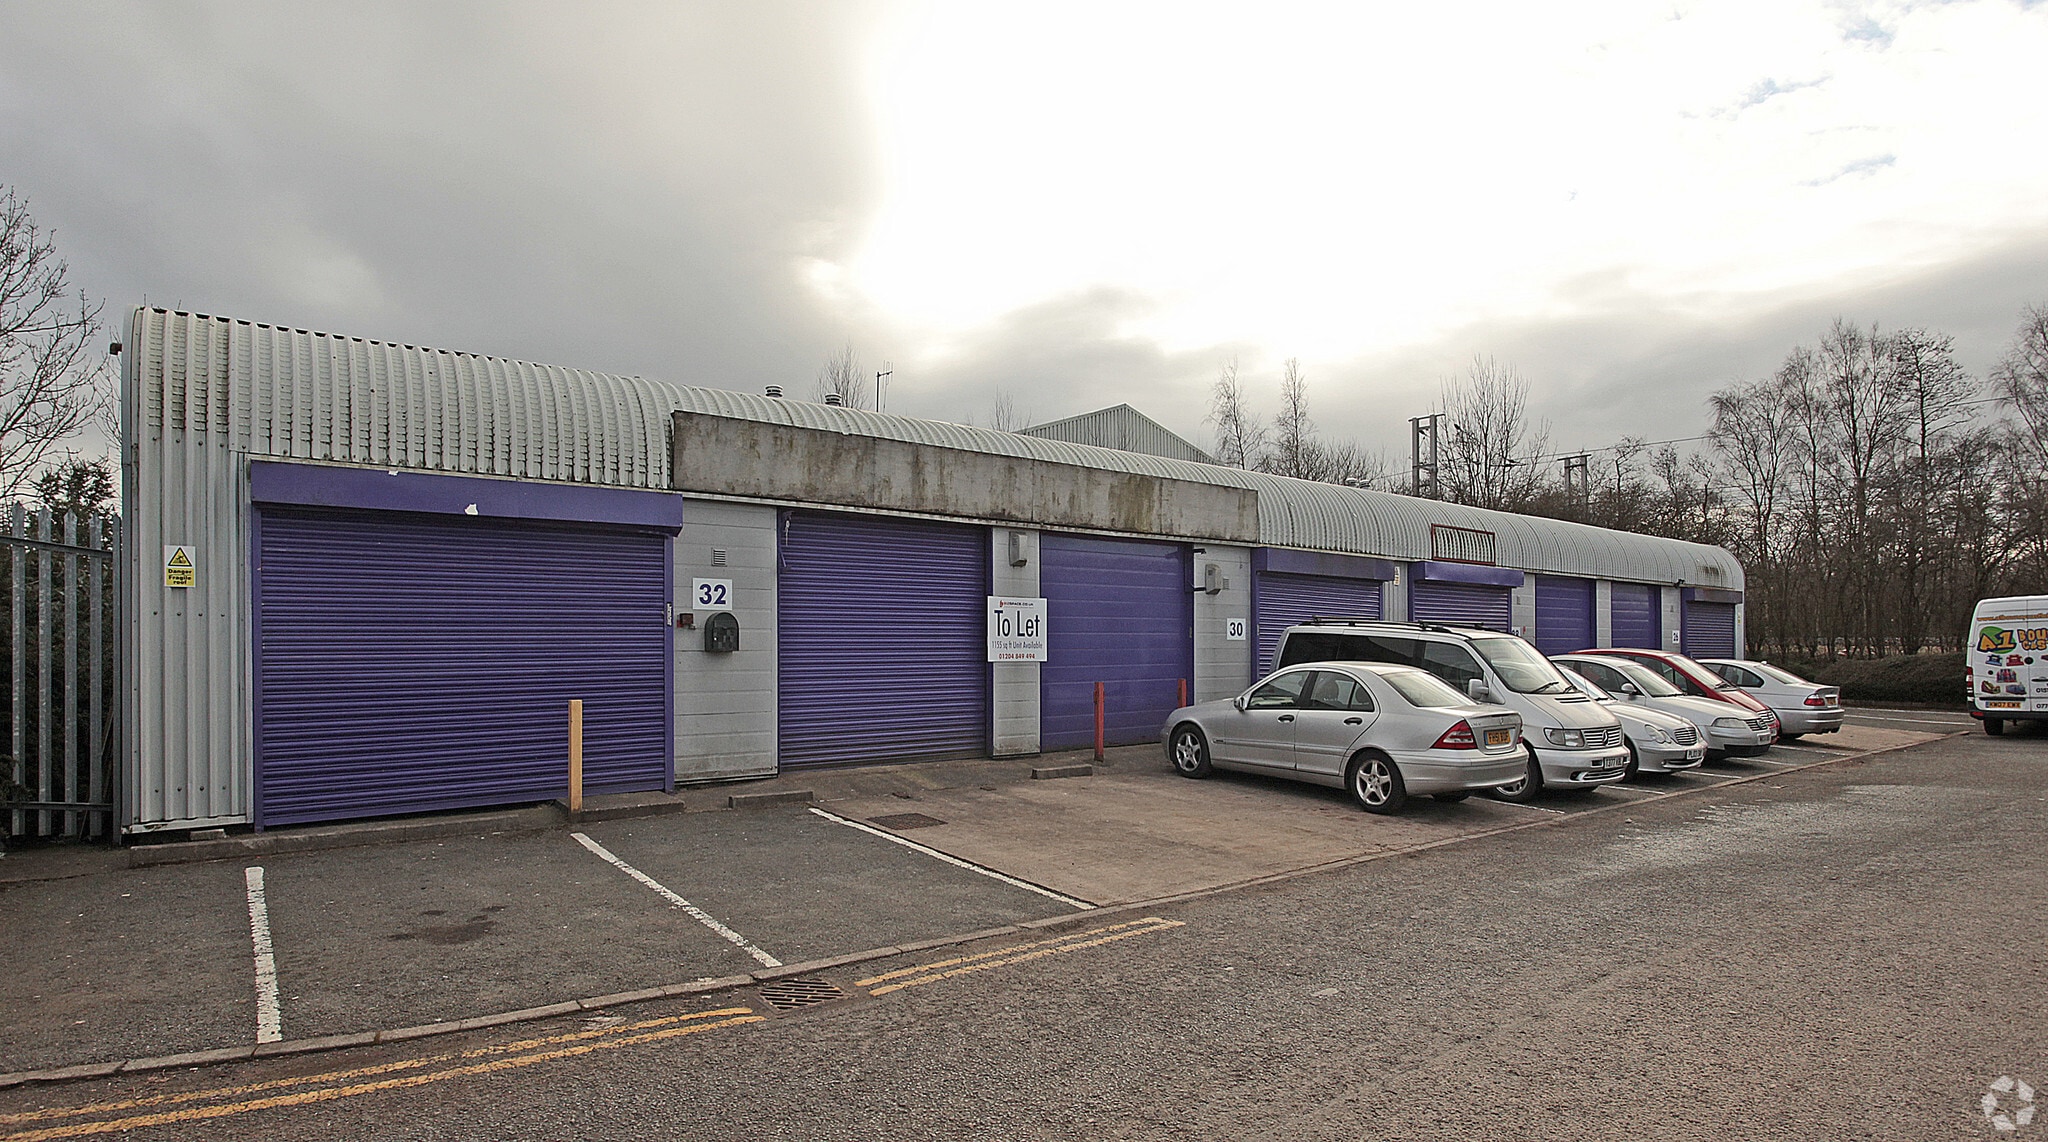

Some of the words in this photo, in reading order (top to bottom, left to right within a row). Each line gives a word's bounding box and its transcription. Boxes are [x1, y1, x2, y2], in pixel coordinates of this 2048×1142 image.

[698, 584, 726, 605] 32
[994, 610, 1010, 637] To
[1017, 610, 1040, 637] Let
[1229, 622, 1243, 636] 30
[1013, 641, 1022, 649] Unit
[1023, 641, 1043, 649] Available
[1976, 630, 2018, 652] A1
